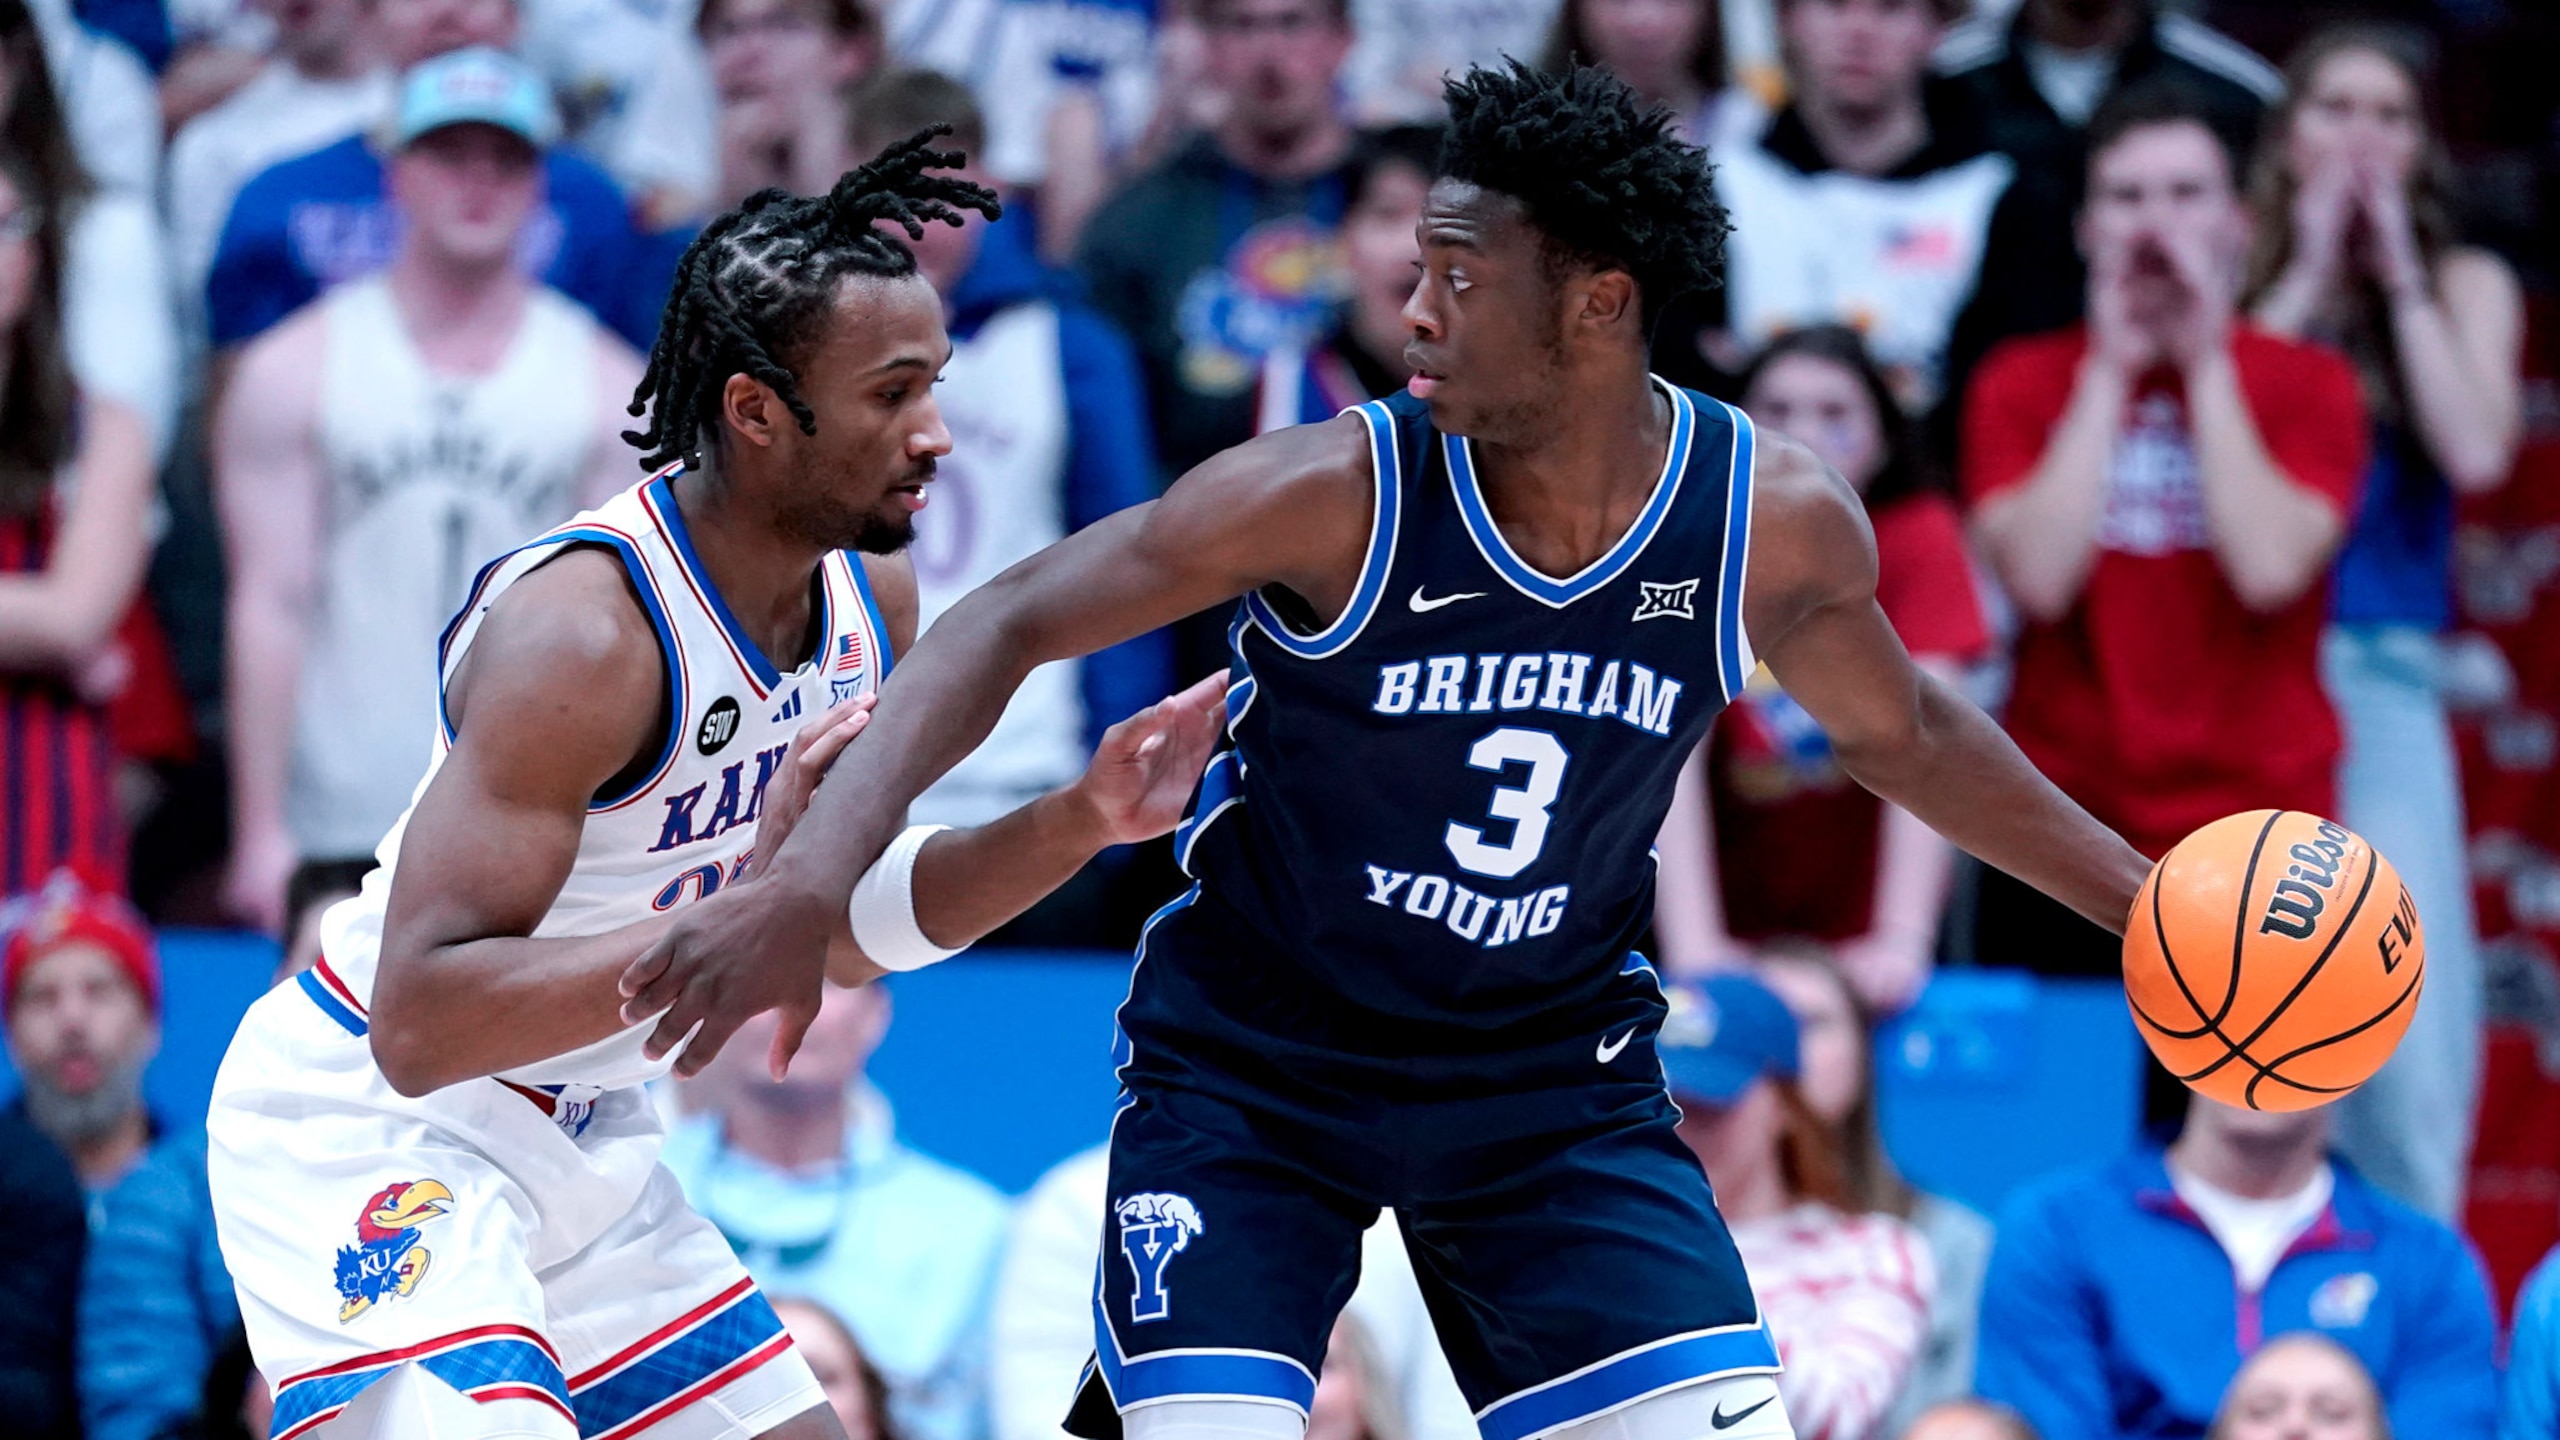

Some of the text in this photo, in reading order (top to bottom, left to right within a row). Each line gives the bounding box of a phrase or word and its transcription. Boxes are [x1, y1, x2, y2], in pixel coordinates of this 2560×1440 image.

[701, 709, 737, 746] SW
[1371, 651, 1684, 738] BRIGHAM
[646, 742, 789, 853] KAN
[1442, 725, 1572, 881] 3
[1364, 862, 1570, 948] YOUNG
[358, 1248, 391, 1280] KU
